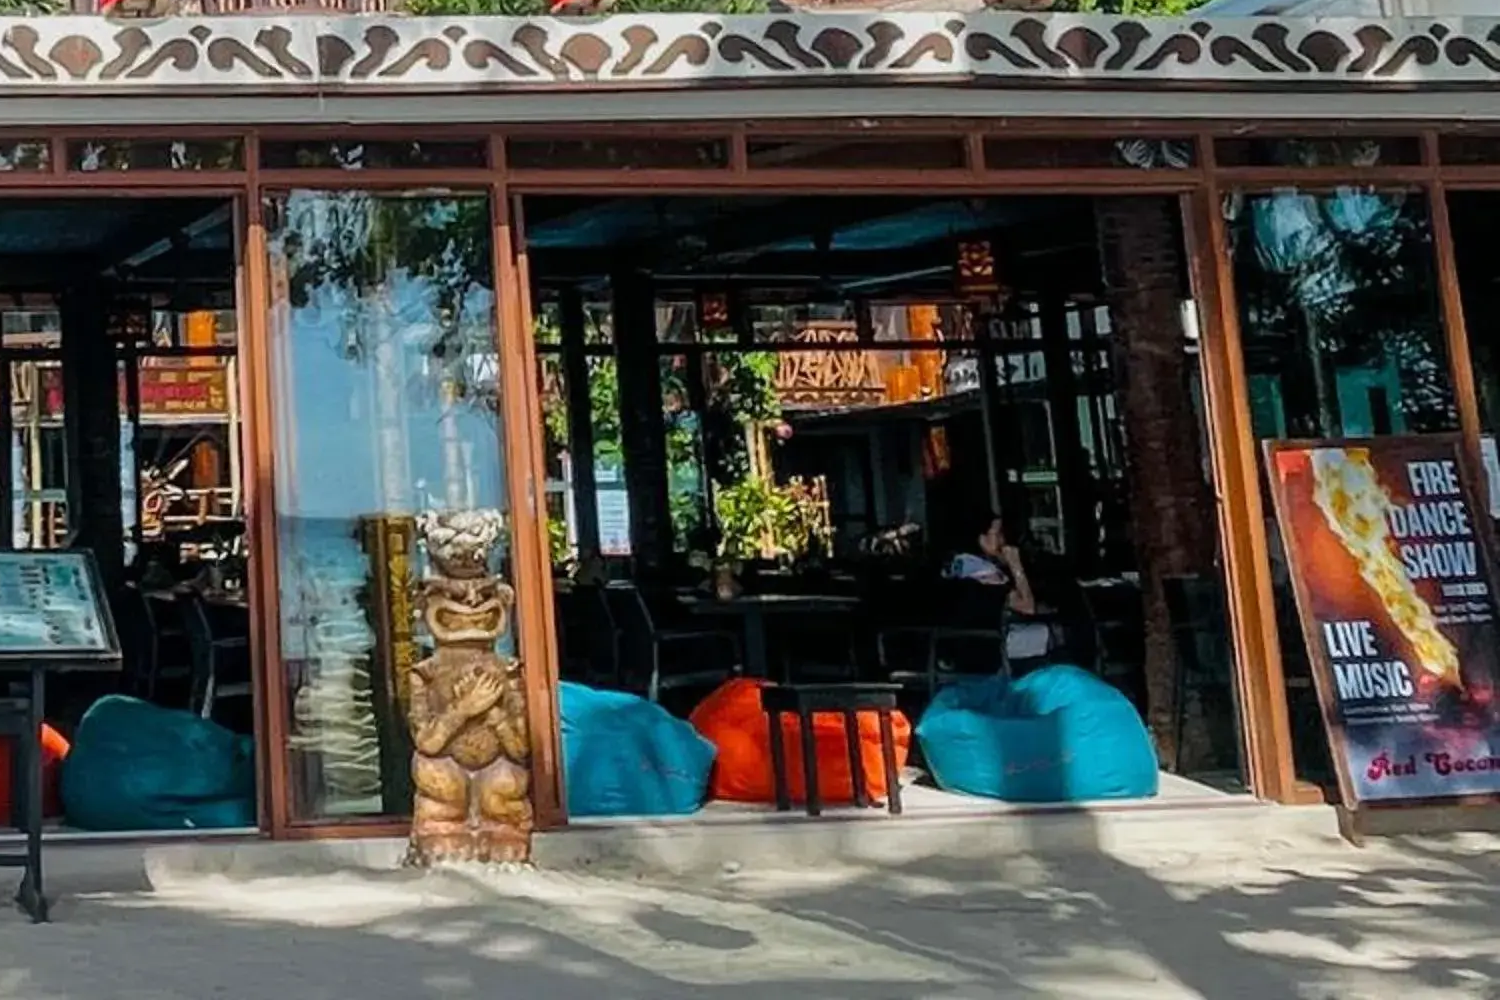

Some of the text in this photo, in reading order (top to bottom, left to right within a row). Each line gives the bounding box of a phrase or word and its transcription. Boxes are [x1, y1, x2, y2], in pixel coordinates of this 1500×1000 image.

[1407, 460, 1460, 496] FIRE
[1390, 502, 1471, 538] DANCE
[1401, 542, 1476, 578] SHOW
[1323, 621, 1377, 657] LIVE
[1333, 661, 1413, 699] MUSIC
[1367, 748, 1416, 780] Red
